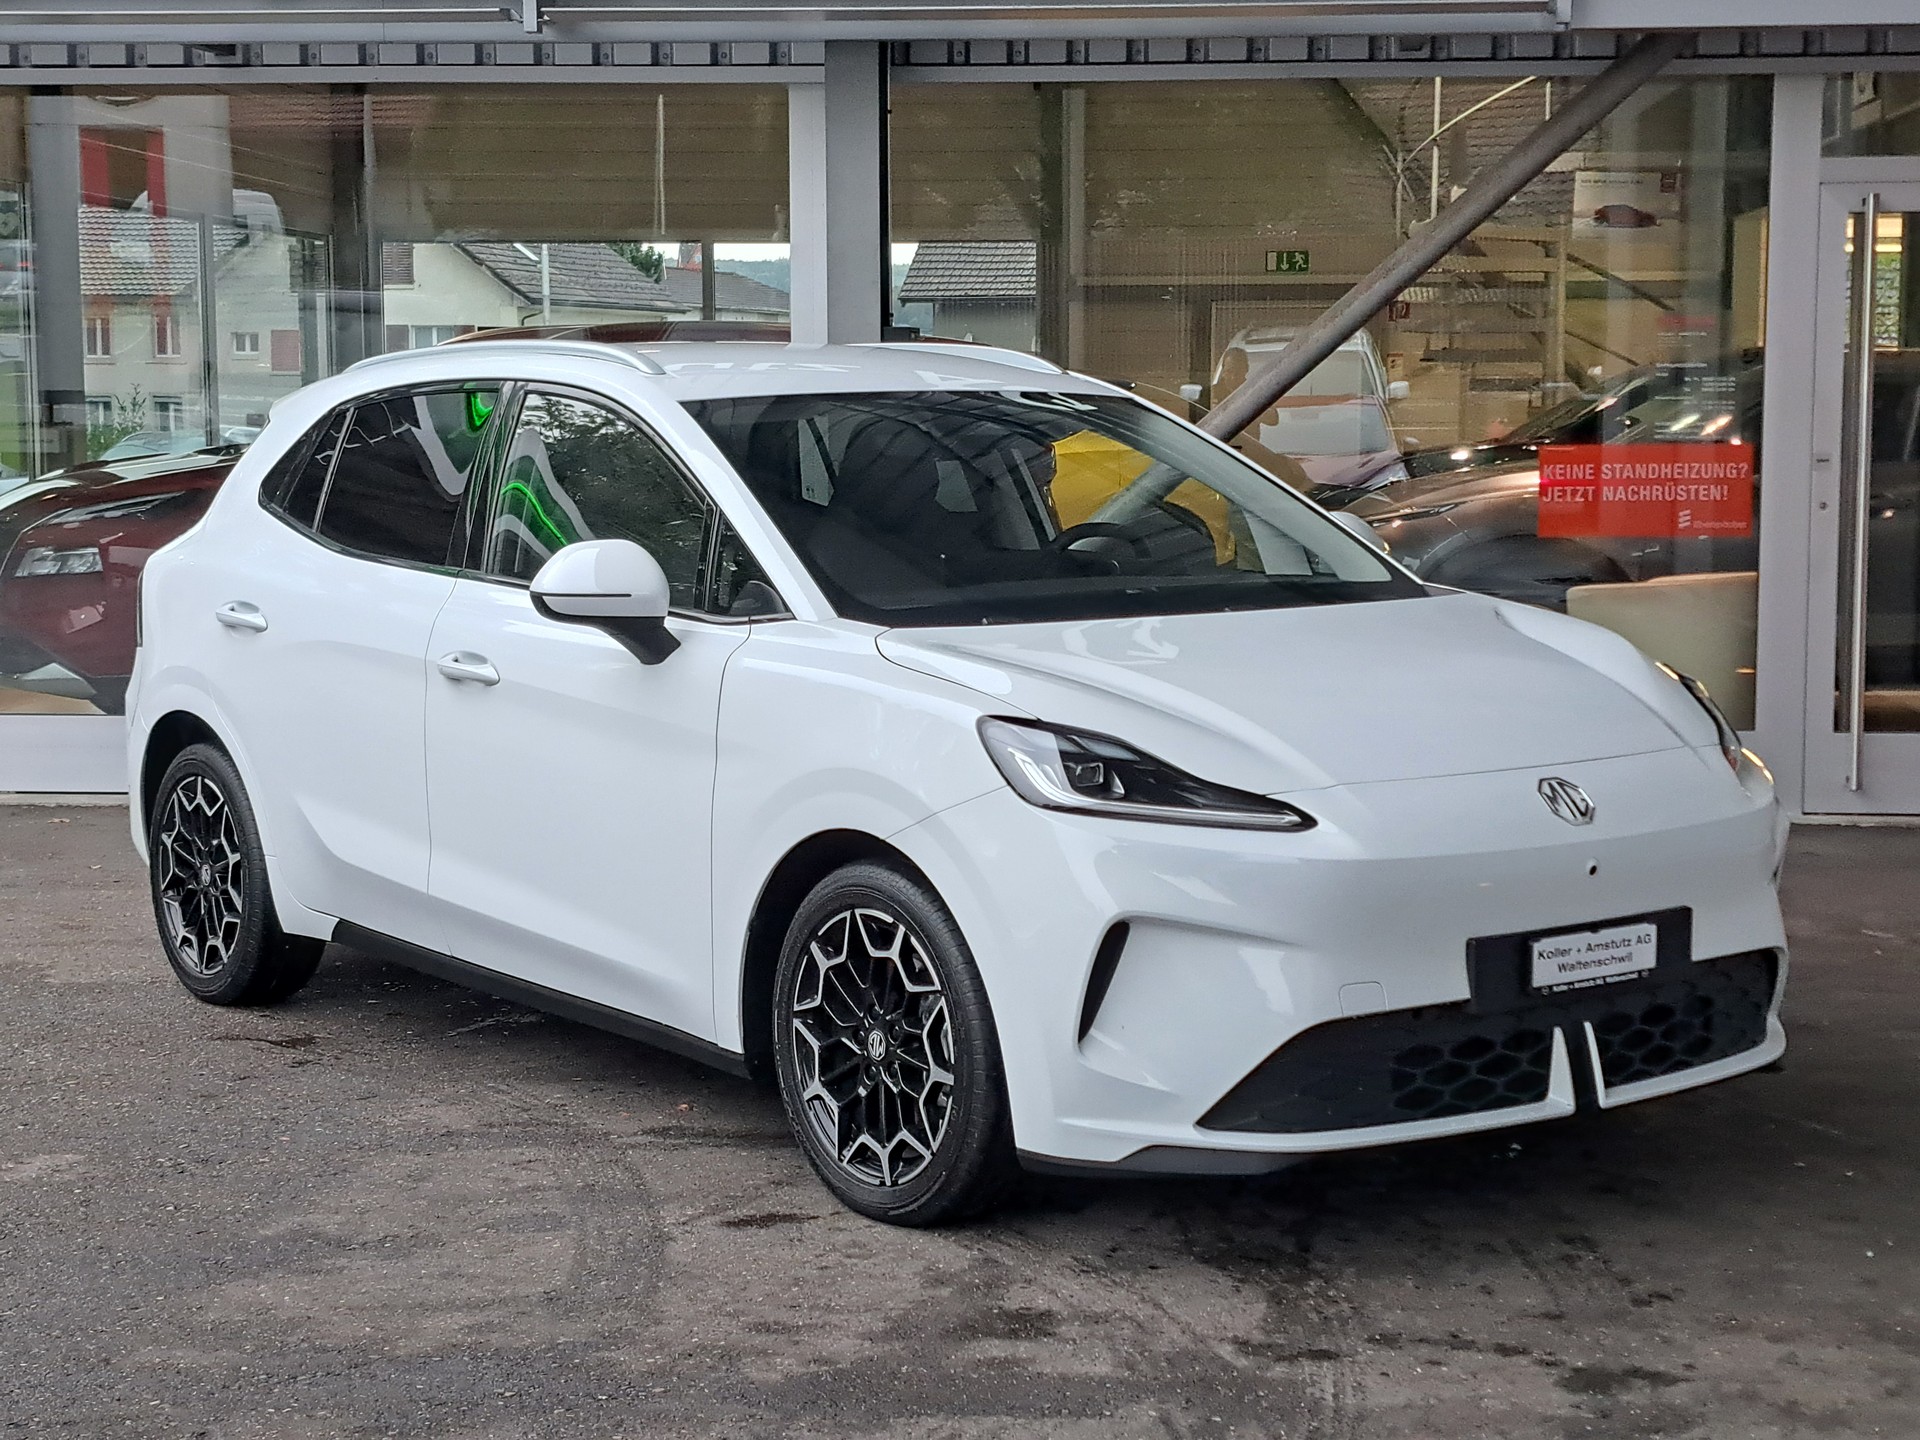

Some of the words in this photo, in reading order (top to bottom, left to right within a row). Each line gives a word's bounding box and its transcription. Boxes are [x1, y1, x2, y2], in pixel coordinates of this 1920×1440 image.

[1543, 463, 1596, 480] KEINE
[1601, 461, 1749, 480] STANDHEIZUNG?
[1542, 485, 1596, 502] JETZT
[1602, 480, 1729, 502] NACHRÜSTEN!
[1538, 776, 1595, 826] MG
[1537, 946, 1572, 961] Koller
[1585, 937, 1632, 954] Amstutz
[1635, 933, 1652, 946] AG
[1557, 951, 1634, 974] Waltenschwil
